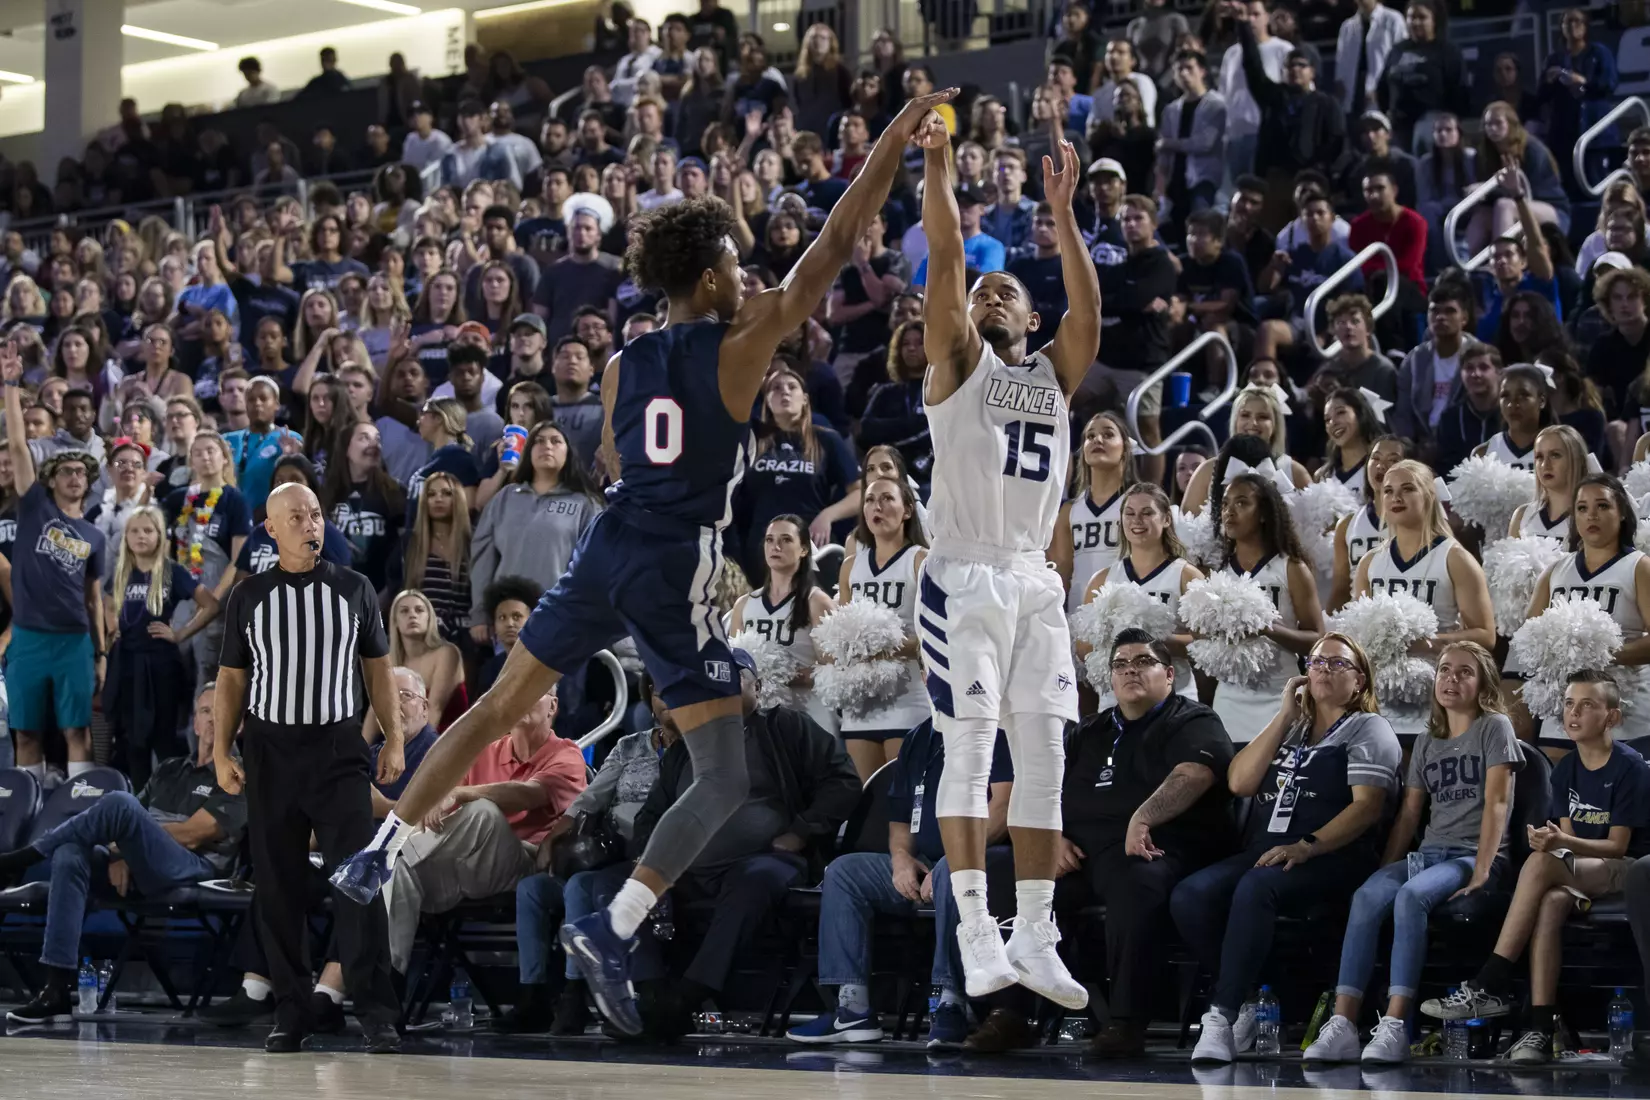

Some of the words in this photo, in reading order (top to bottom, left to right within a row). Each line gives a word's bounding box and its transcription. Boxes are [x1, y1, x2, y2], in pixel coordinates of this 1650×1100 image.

[645, 396, 683, 464] 0
[1003, 420, 1055, 482] 15
[547, 500, 578, 516] CBU
[1072, 521, 1120, 551] CBU
[966, 688, 986, 696] adidas
[1423, 755, 1480, 794] CBU
